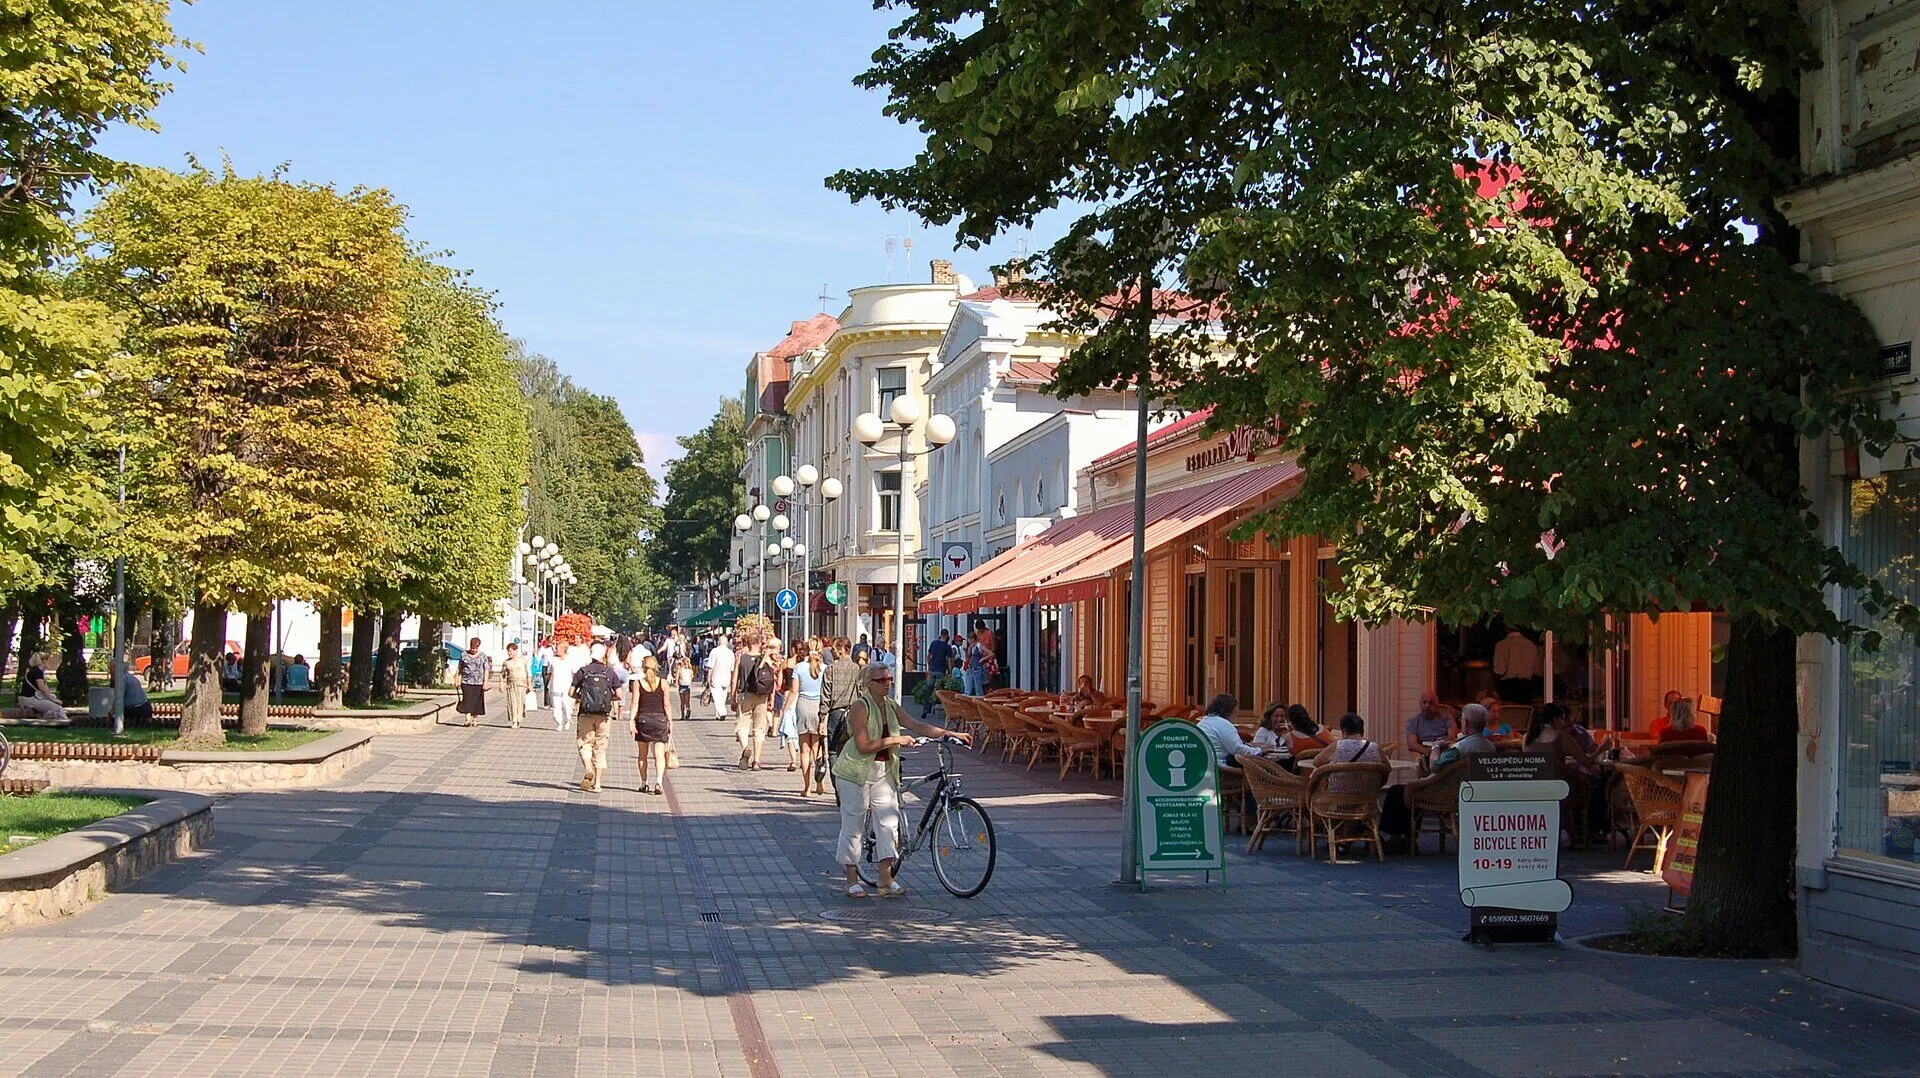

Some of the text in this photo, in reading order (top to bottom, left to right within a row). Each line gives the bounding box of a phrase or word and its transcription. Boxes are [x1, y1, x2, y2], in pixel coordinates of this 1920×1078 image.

[1478, 757, 1523, 765] VELOSIPĒDU
[1473, 814, 1547, 832] VELONOMA
[1473, 836, 1548, 851] BICYCLE RENT
[1473, 858, 1512, 870] 10-19
